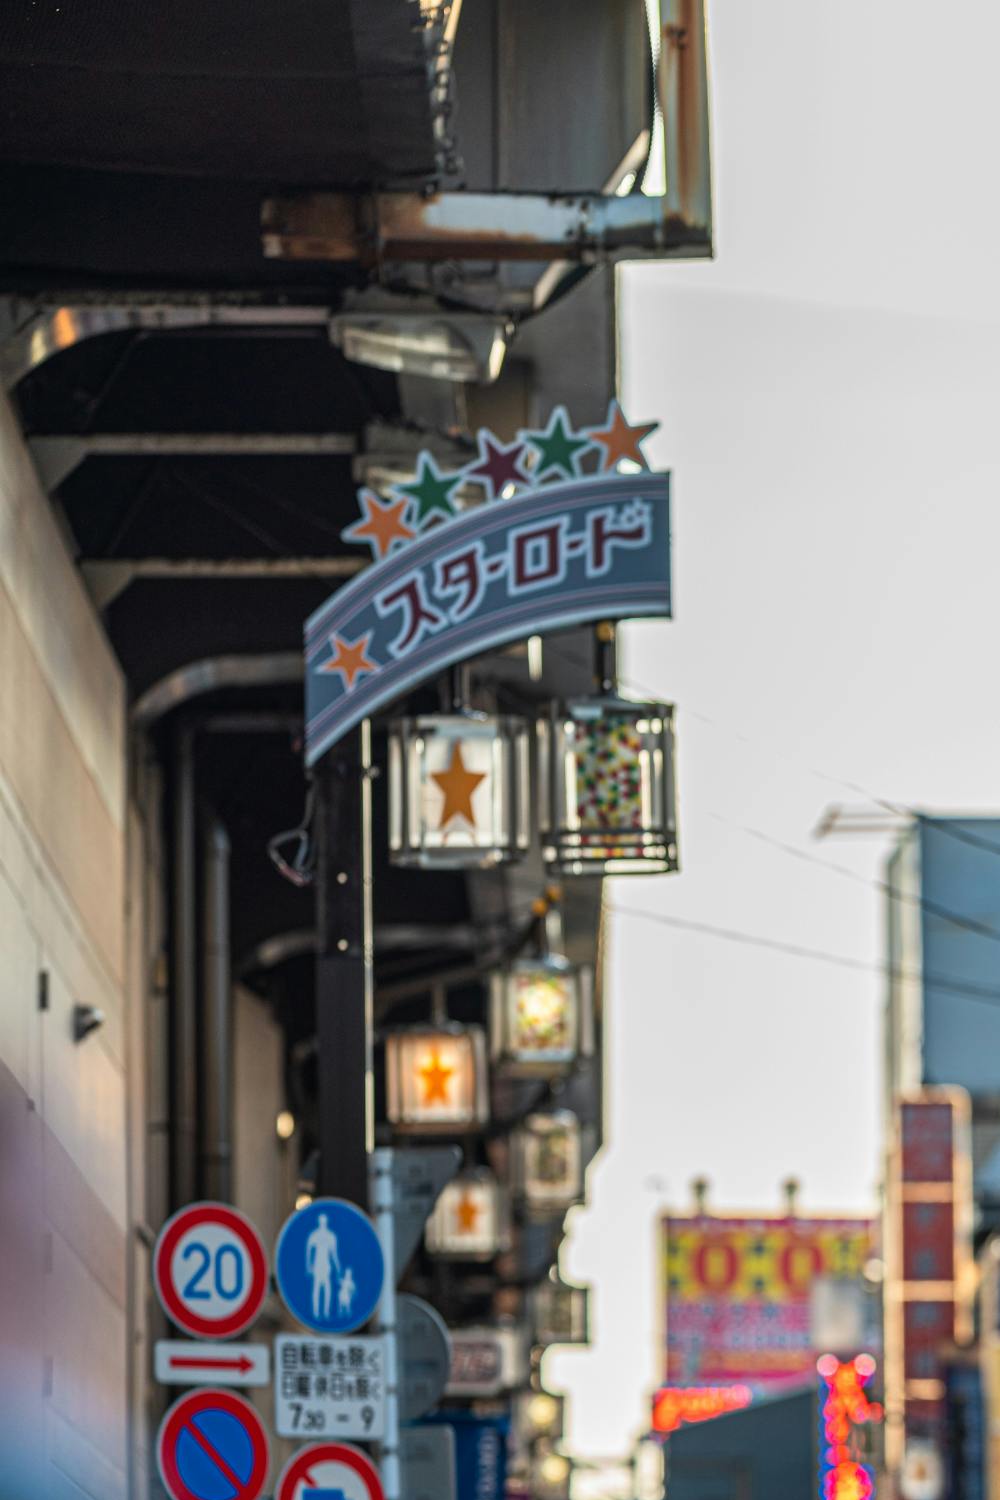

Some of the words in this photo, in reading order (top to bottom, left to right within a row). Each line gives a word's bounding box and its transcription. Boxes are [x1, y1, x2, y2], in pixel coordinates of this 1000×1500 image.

[375, 497, 653, 658] スターロード
[181, 1241, 244, 1301] 20
